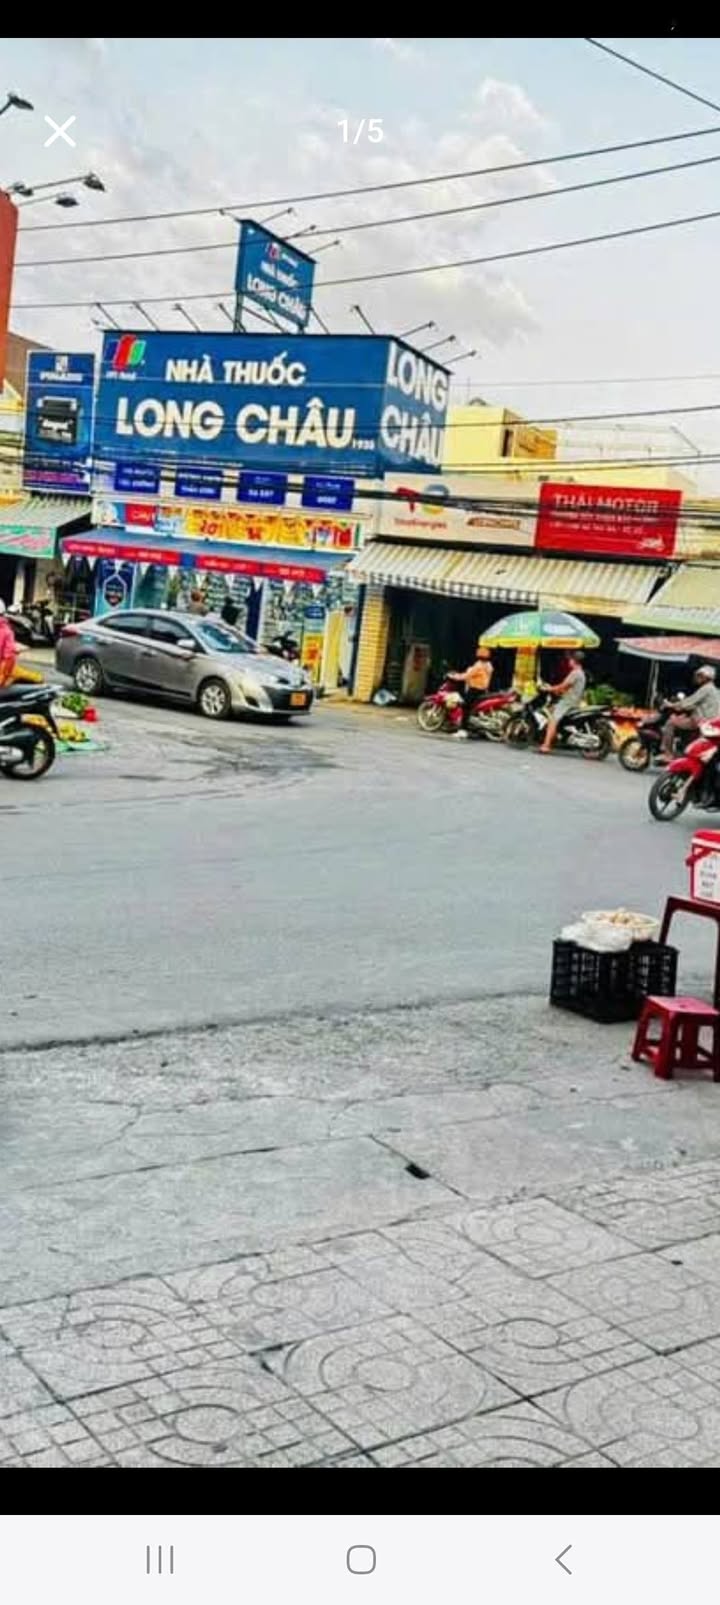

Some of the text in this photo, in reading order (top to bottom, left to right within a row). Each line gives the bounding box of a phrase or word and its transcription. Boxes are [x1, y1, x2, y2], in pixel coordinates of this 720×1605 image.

[165, 351, 307, 386] NHÀ THUỐC
[386, 340, 449, 413] LONG
[115, 397, 225, 441] LONG
[236, 396, 356, 449] CHÂU
[380, 404, 444, 467] CHÂU
[593, 497, 660, 514] MOTOR
